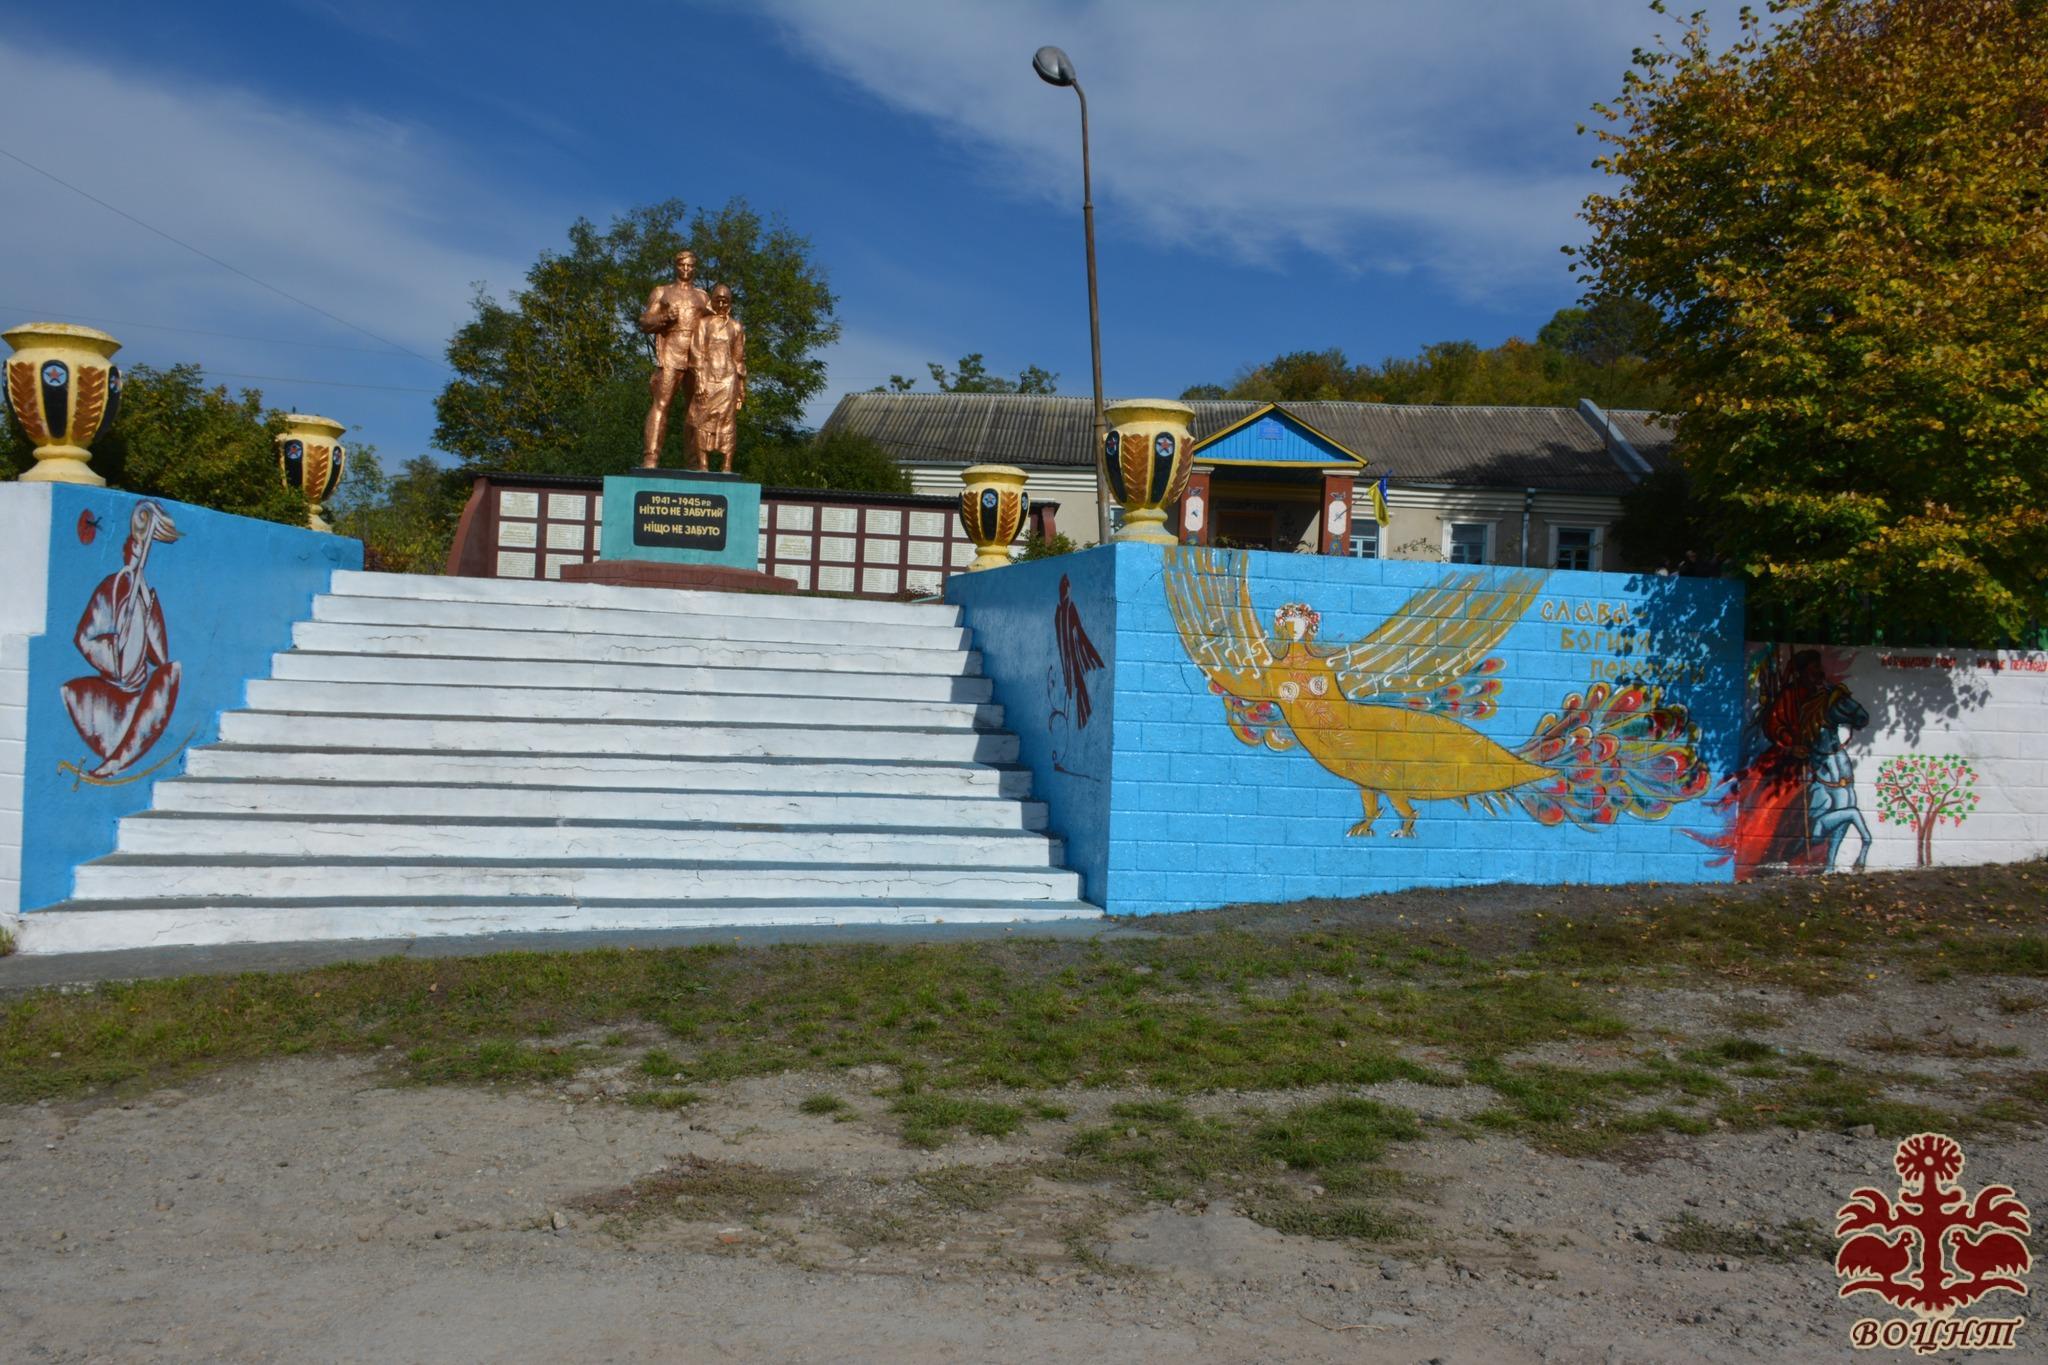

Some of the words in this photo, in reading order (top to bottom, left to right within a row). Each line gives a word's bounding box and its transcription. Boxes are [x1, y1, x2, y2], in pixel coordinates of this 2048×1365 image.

[652, 496, 670, 504] 1941
[678, 497, 700, 506] 1945
[639, 504, 669, 515] НІХТО
[670, 507, 681, 516] НЕ
[683, 507, 725, 518] ЗАБУТИЙ
[672, 524, 683, 534] НЕ
[685, 525, 720, 536] ЗАБУТО
